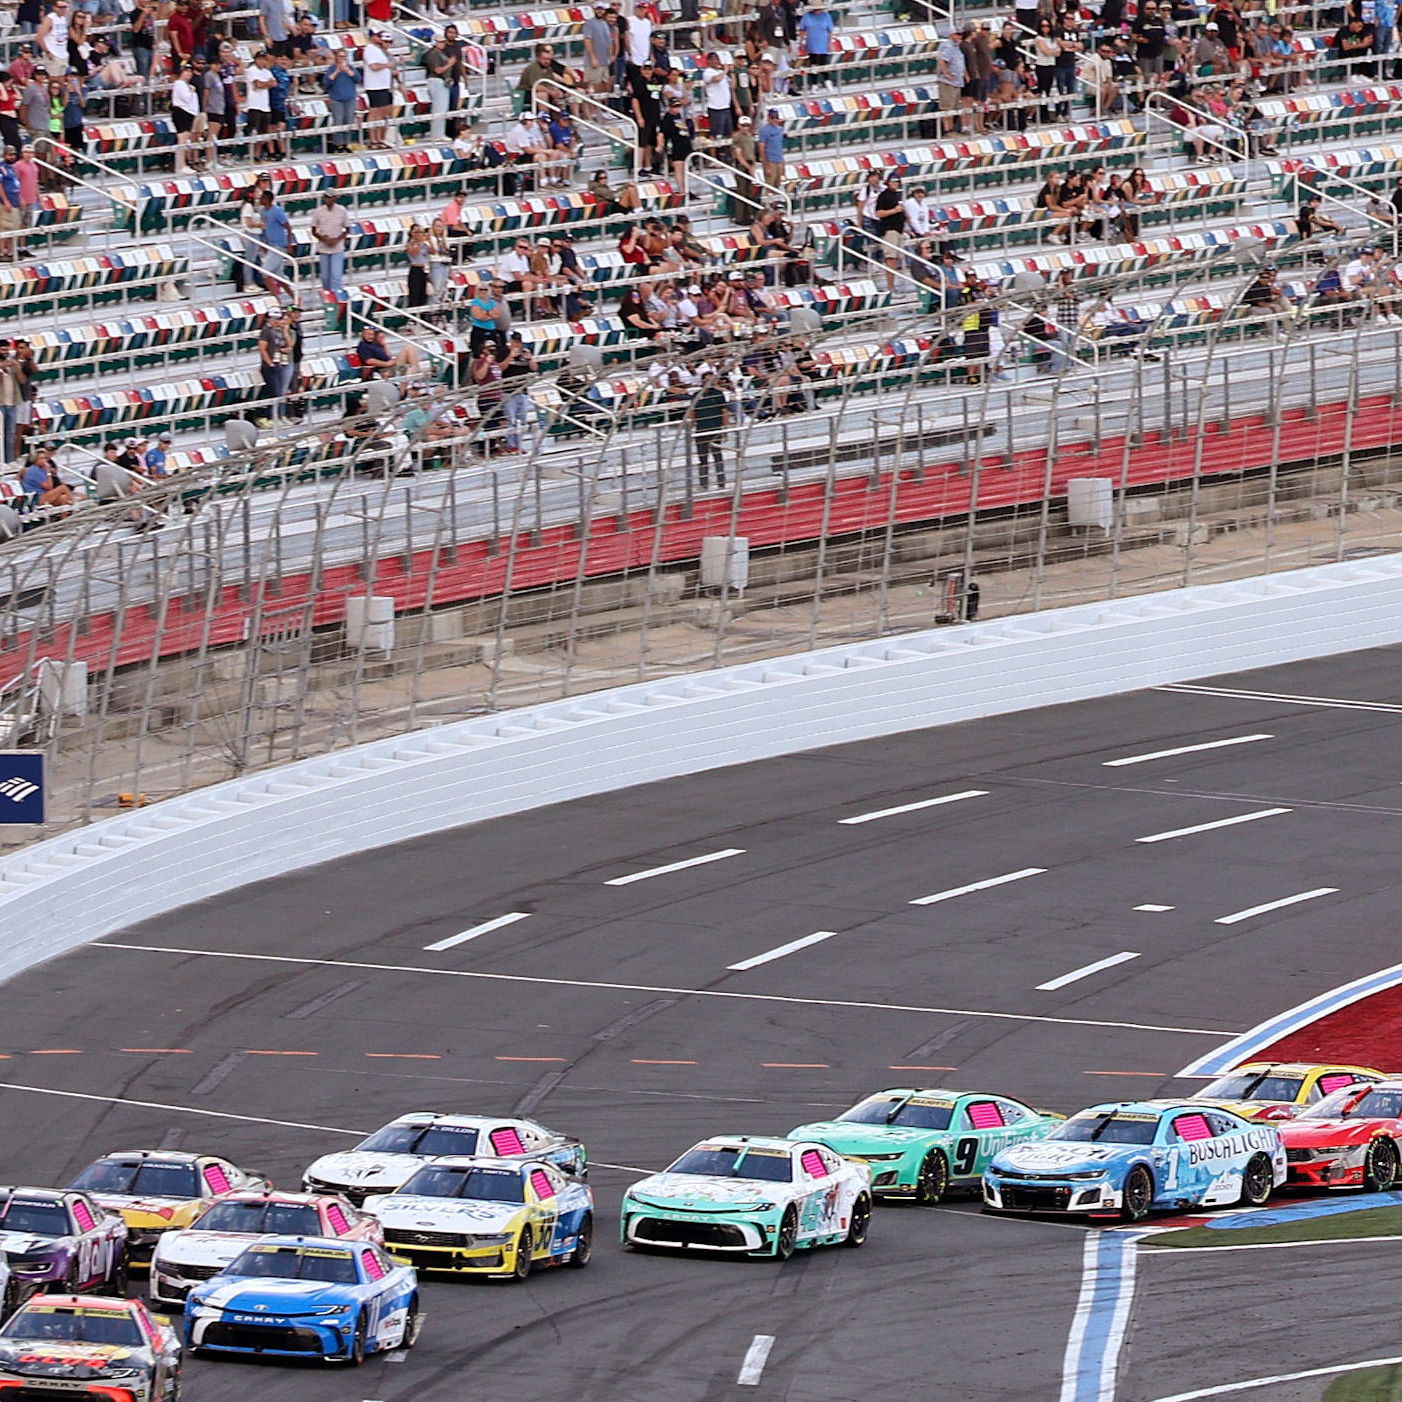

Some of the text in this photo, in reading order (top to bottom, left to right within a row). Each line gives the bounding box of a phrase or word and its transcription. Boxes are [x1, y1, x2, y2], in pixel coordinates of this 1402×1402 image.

[953, 1137, 979, 1176] 9
[1162, 1147, 1181, 1191] 1
[234, 1314, 286, 1324] CAMRY
